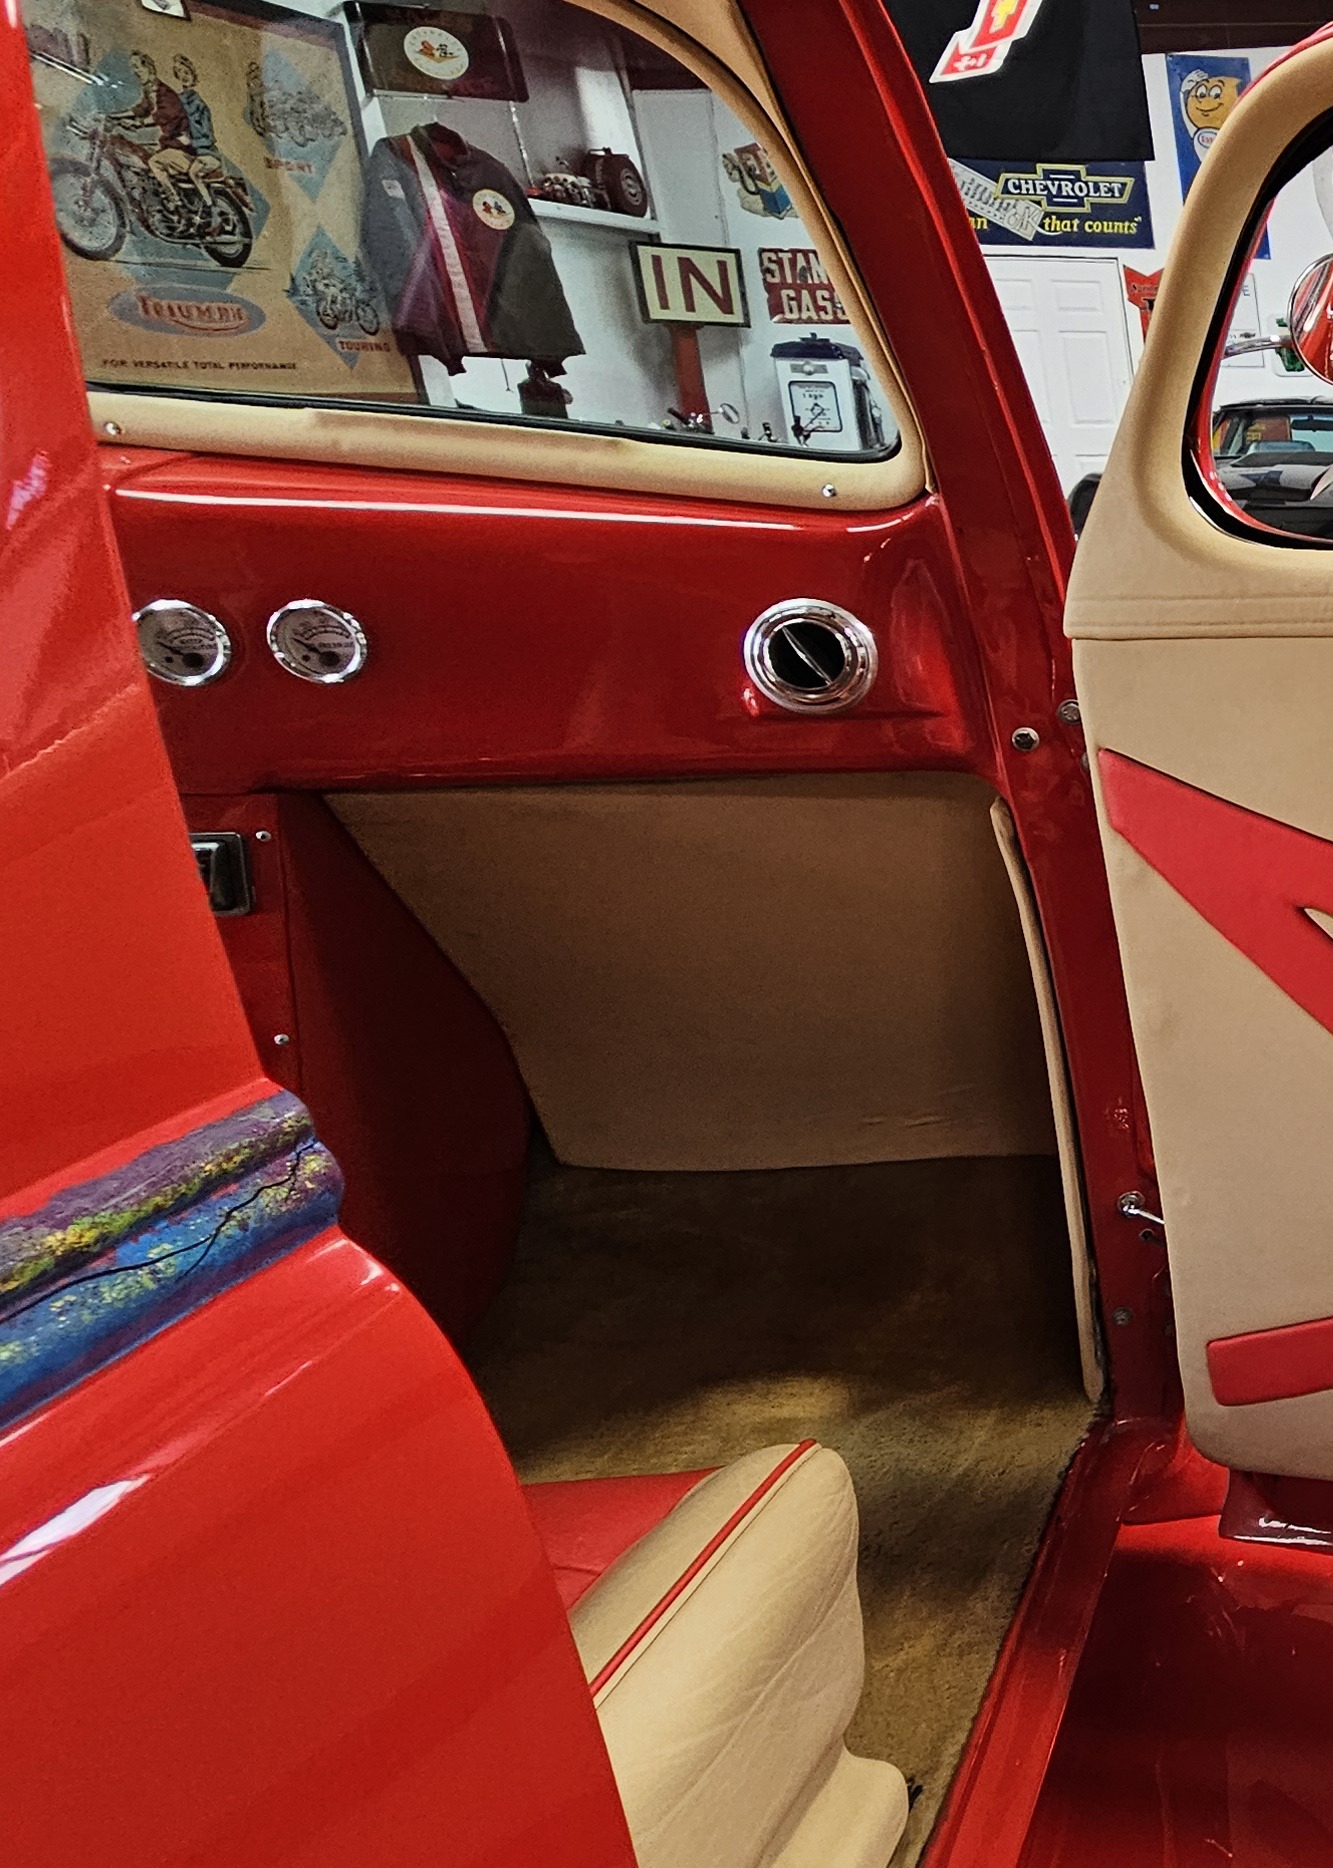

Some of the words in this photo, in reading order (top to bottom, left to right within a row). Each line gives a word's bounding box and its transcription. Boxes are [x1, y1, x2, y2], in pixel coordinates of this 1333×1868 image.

[1007, 177, 1123, 198] CHEVROLET
[1043, 215, 1080, 233] that
[651, 253, 735, 315] IN
[193, 360, 225, 370] TOTAL
